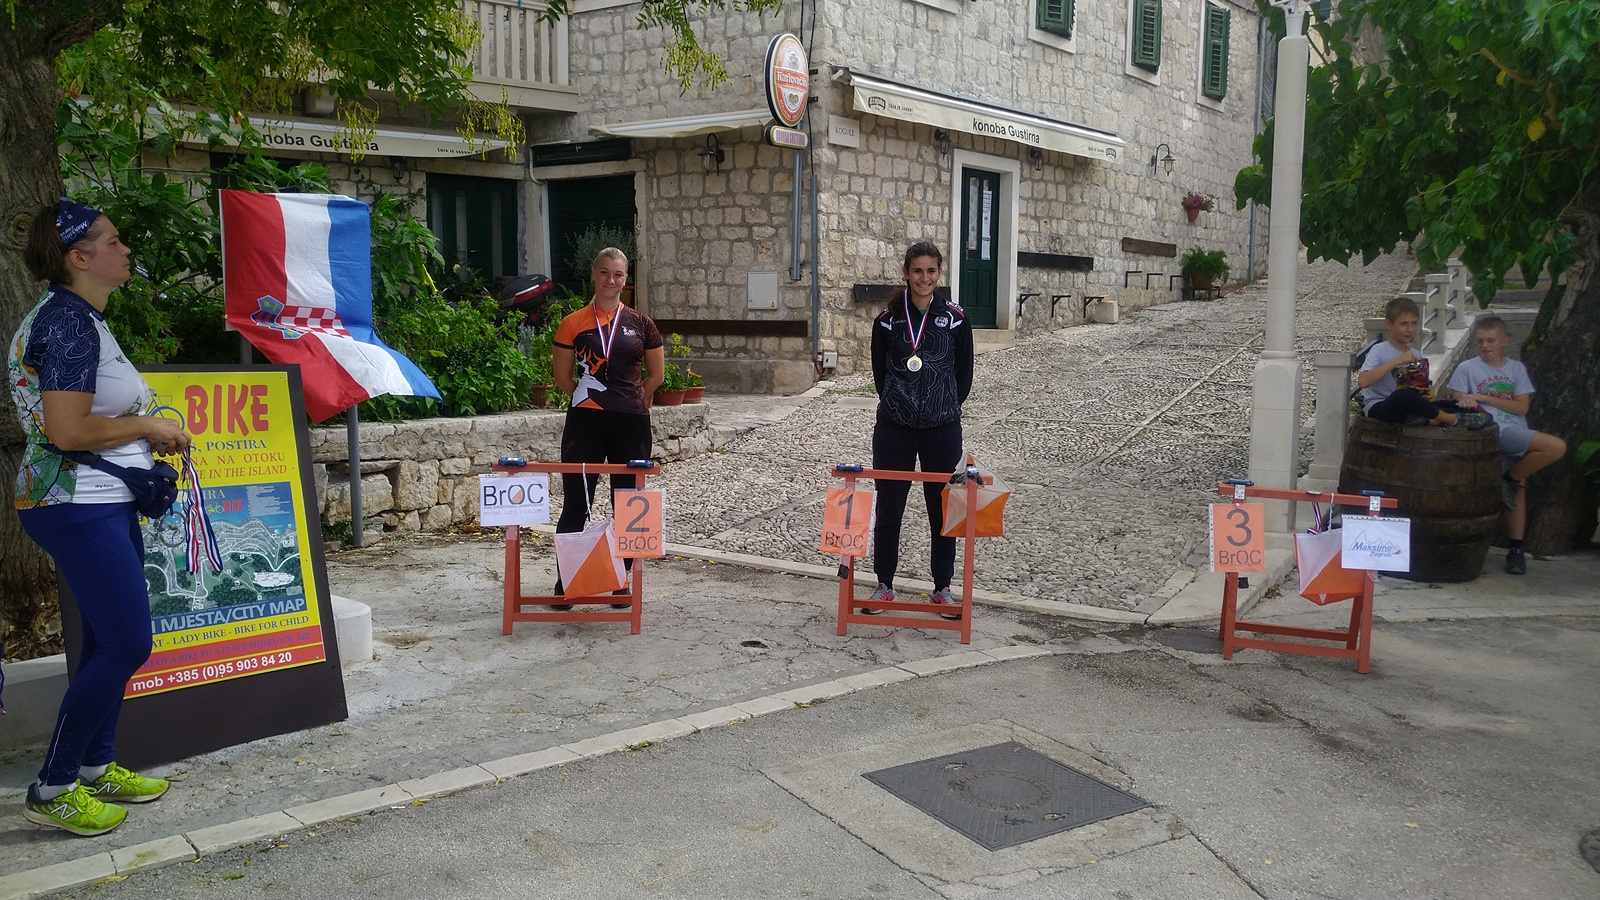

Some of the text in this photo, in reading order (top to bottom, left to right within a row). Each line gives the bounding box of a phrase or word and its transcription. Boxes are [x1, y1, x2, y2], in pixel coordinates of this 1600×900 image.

[262, 133, 305, 146] noba
[972, 118, 1040, 144] konoba Gustirna
[185, 384, 269, 437] BIKE
[206, 439, 267, 452] POSTIRA
[217, 455, 235, 466] NA
[243, 452, 285, 464] OTOKU
[208, 468, 226, 479] IN
[225, 467, 246, 478] THE
[248, 464, 287, 476] ISLAND
[203, 489, 226, 500] IRA
[483, 483, 544, 506] BrOC
[625, 495, 650, 532] 2
[839, 493, 853, 529] 1
[1226, 508, 1252, 546] 3
[618, 536, 658, 551] BrOC
[825, 531, 864, 549] BrOC
[1352, 542, 1393, 552] Maksimir
[1219, 549, 1262, 565] BrOC
[161, 603, 266, 632] MJESTA/CITY
[269, 598, 305, 613] MAP
[152, 639, 164, 649] AT
[173, 633, 200, 645] LADY
[203, 629, 227, 641] BIKE
[234, 623, 257, 635] BIKE
[259, 620, 278, 631] FOR
[279, 615, 309, 628] CHILD
[143, 632, 312, 669] RY OF A BIKE TO A PLACE WHERE YOU ARE
[132, 651, 292, 692] mob +385 (0)95 903 84 20
